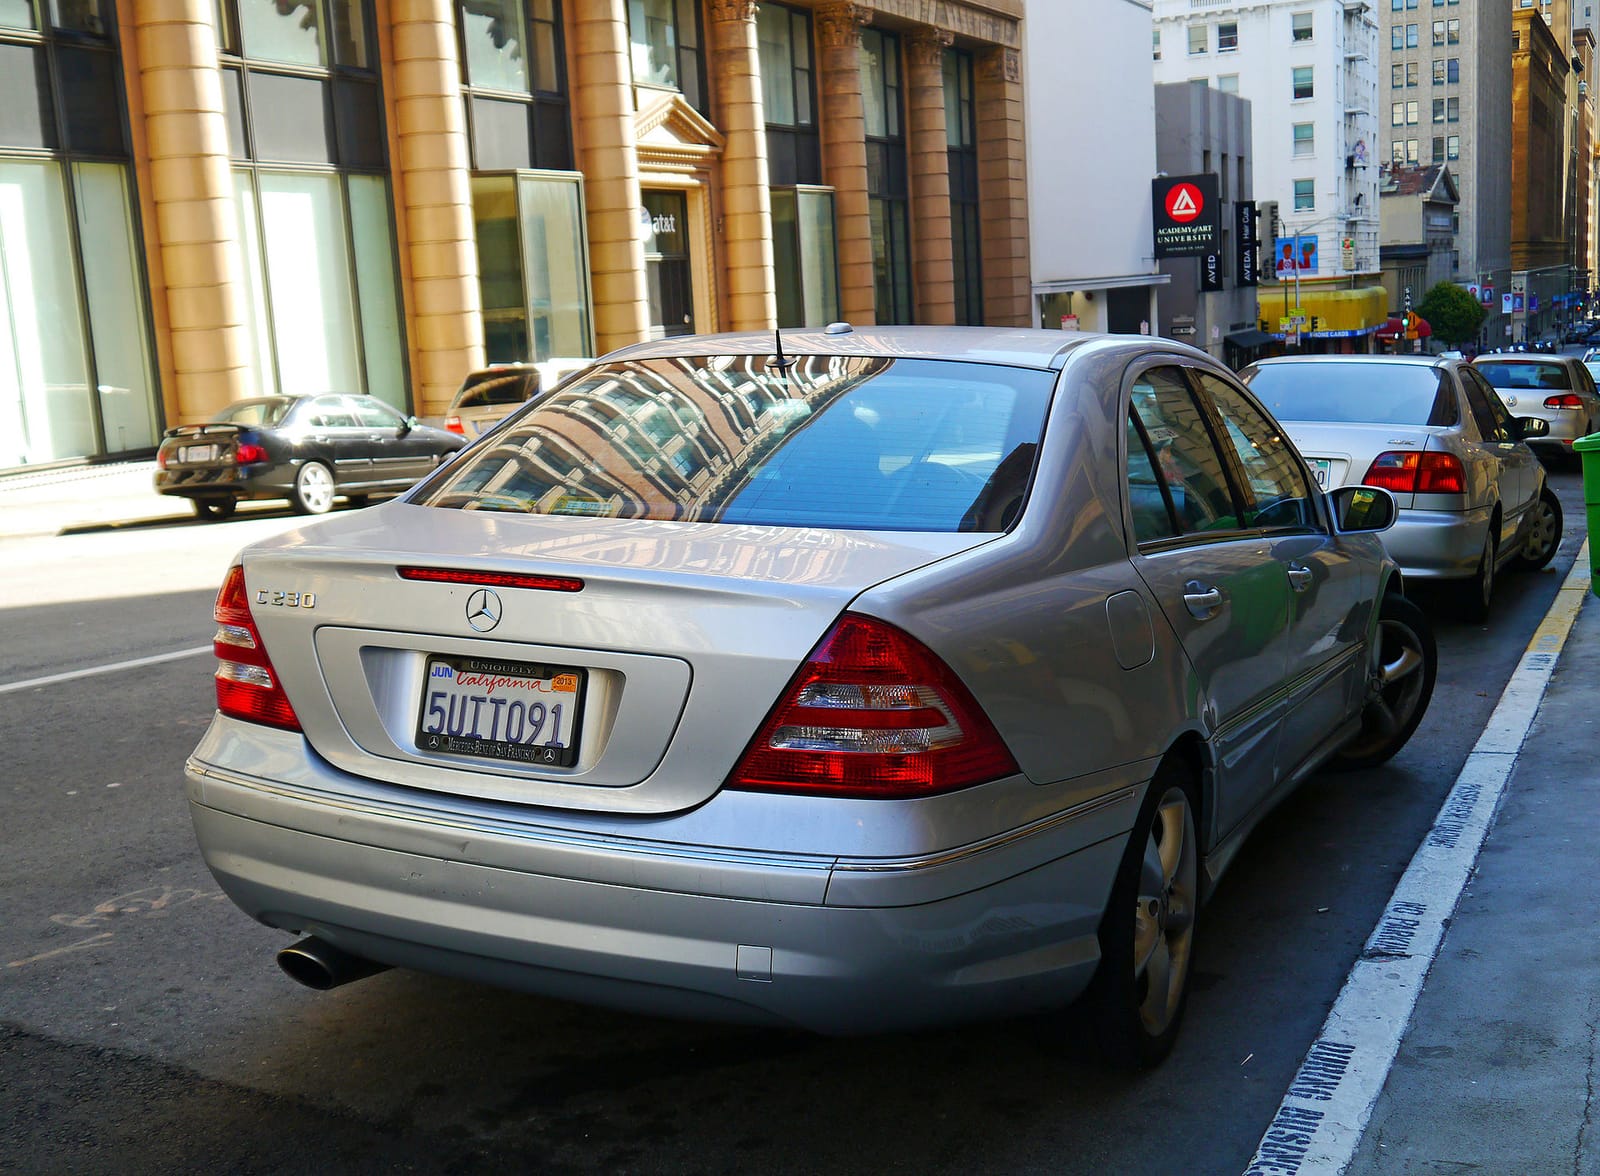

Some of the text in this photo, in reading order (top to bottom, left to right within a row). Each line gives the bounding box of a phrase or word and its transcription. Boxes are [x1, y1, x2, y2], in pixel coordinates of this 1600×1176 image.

[652, 213, 676, 233] at&t
[1157, 226, 1192, 235] ACADEMY
[1198, 224, 1213, 232] ART
[1242, 224, 1250, 239] Hair
[1157, 233, 1213, 243] UNIVERSITY
[1207, 254, 1216, 284] AVED
[1243, 249, 1251, 281] AVEDA
[256, 588, 317, 609] C 230
[431, 666, 453, 679] JUN
[556, 676, 573, 687] 2013
[456, 670, 552, 695] California
[427, 691, 564, 749] 5UIT091
[496, 743, 507, 757] SAN
[507, 744, 536, 761] FRANCISCO
[1392, 900, 1427, 916] NO
